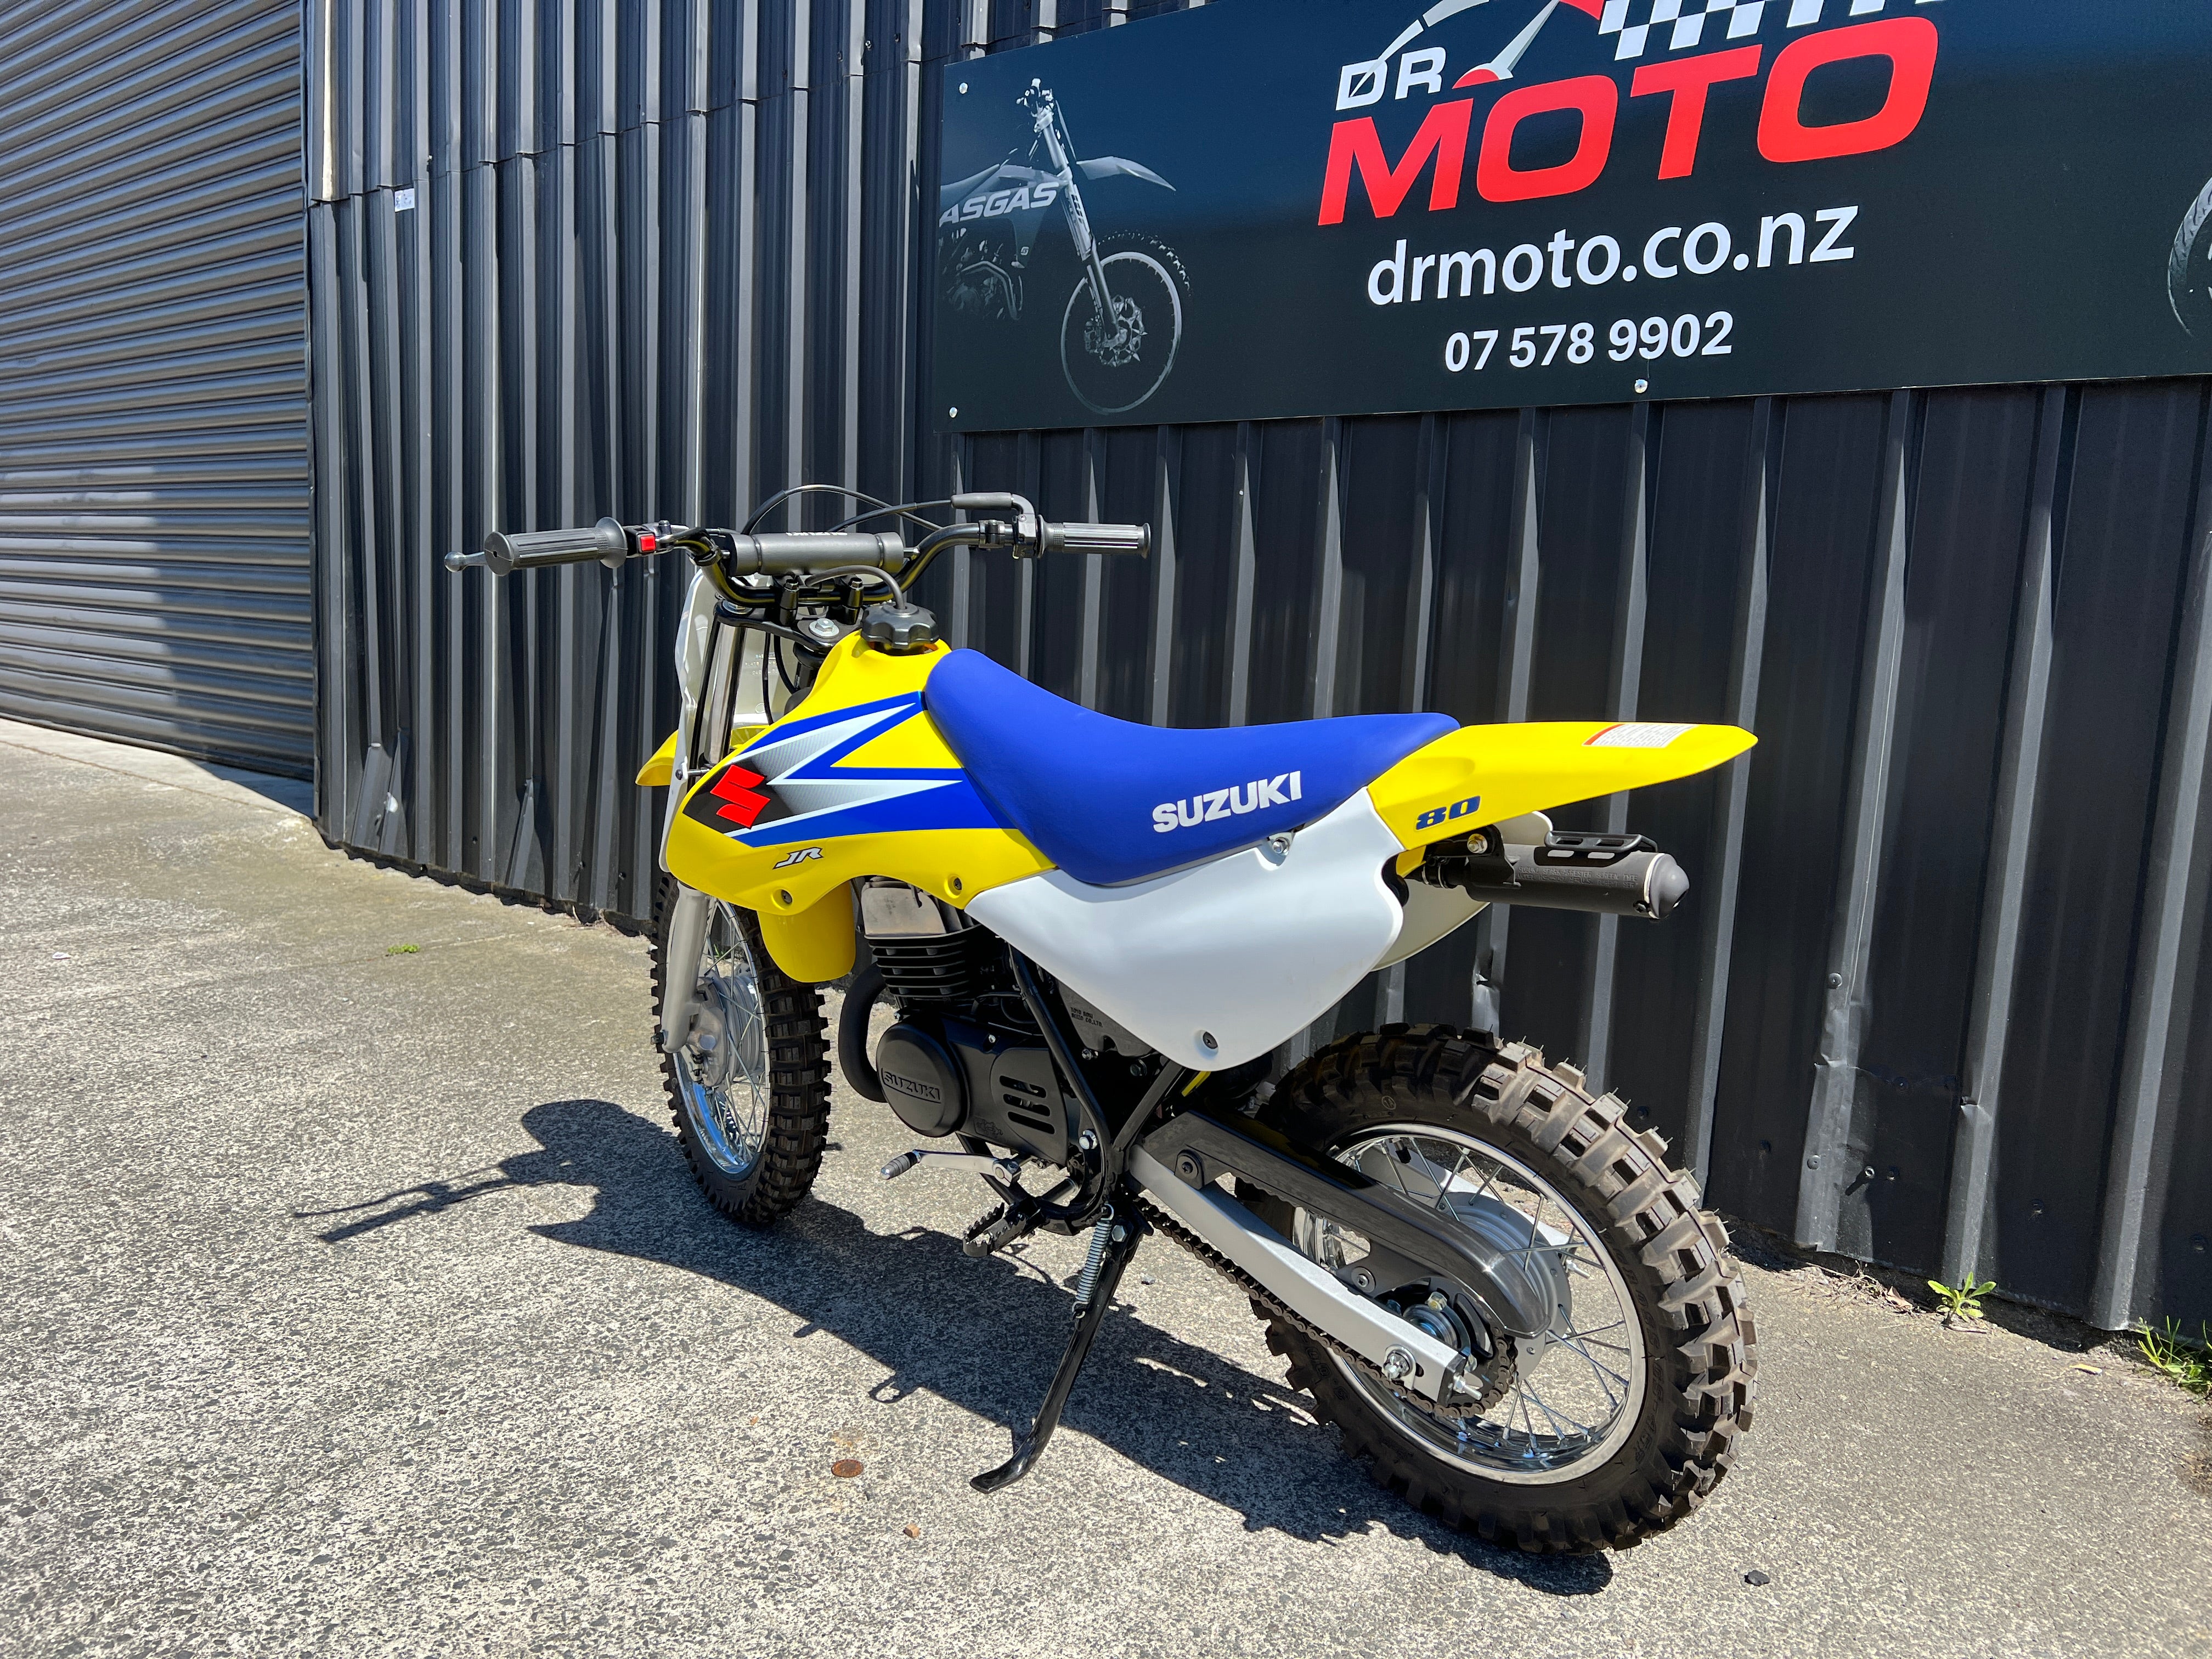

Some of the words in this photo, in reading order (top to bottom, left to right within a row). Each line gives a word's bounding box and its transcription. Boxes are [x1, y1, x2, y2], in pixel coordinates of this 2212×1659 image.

[1335, 46, 1446, 111] DR
[1318, 16, 1939, 226] MOTO
[1367, 205, 1859, 306] drmoto.co.nz
[1445, 329, 1499, 372] 07
[1509, 322, 1594, 368] 578
[1608, 311, 1733, 362] 9902
[1152, 770, 1302, 833] SUZUKI
[1415, 795, 1481, 830] 80
[772, 847, 824, 870] JR
[884, 1071, 940, 1101] SUZUKI
